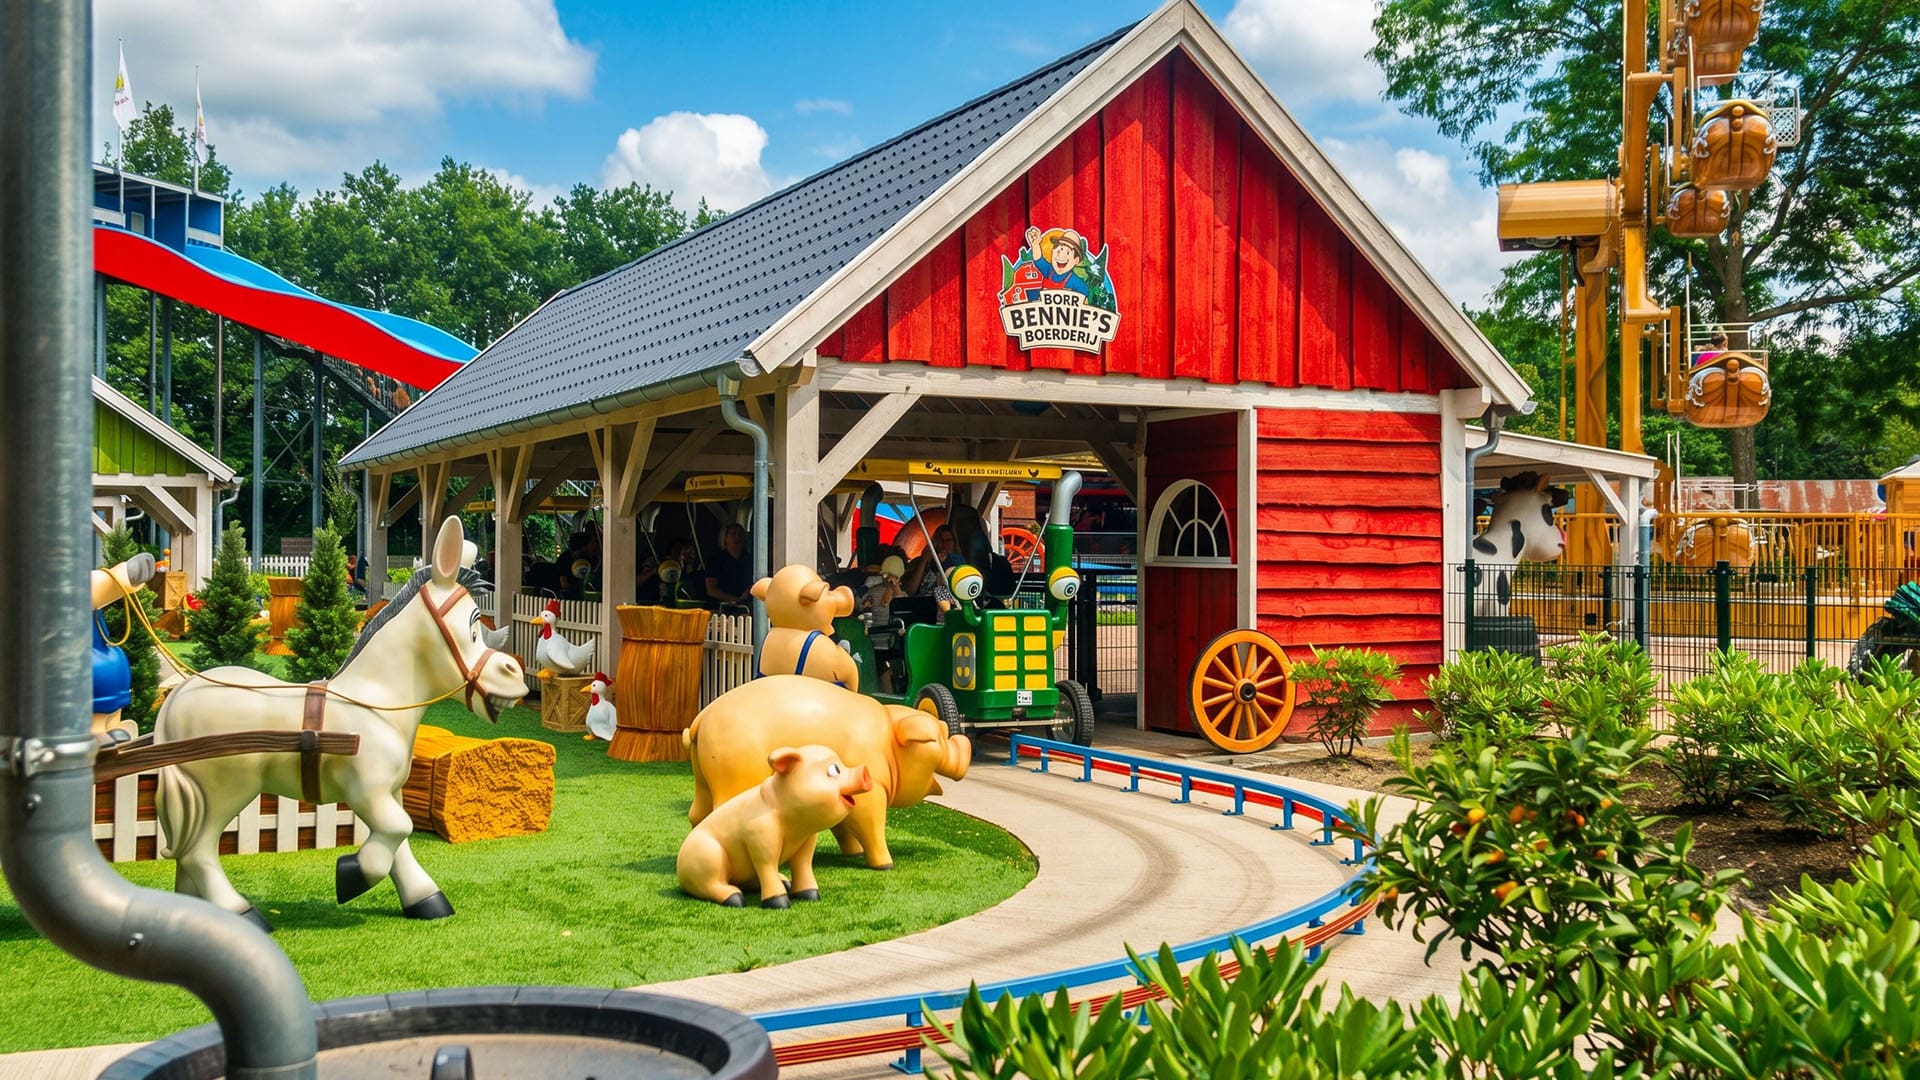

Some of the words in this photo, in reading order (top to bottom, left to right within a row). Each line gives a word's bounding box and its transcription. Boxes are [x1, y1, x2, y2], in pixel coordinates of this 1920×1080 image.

[1043, 294, 1080, 307] BORR
[1010, 306, 1112, 333] BENNIE'S
[1025, 328, 1098, 346] BOERDERIJ
